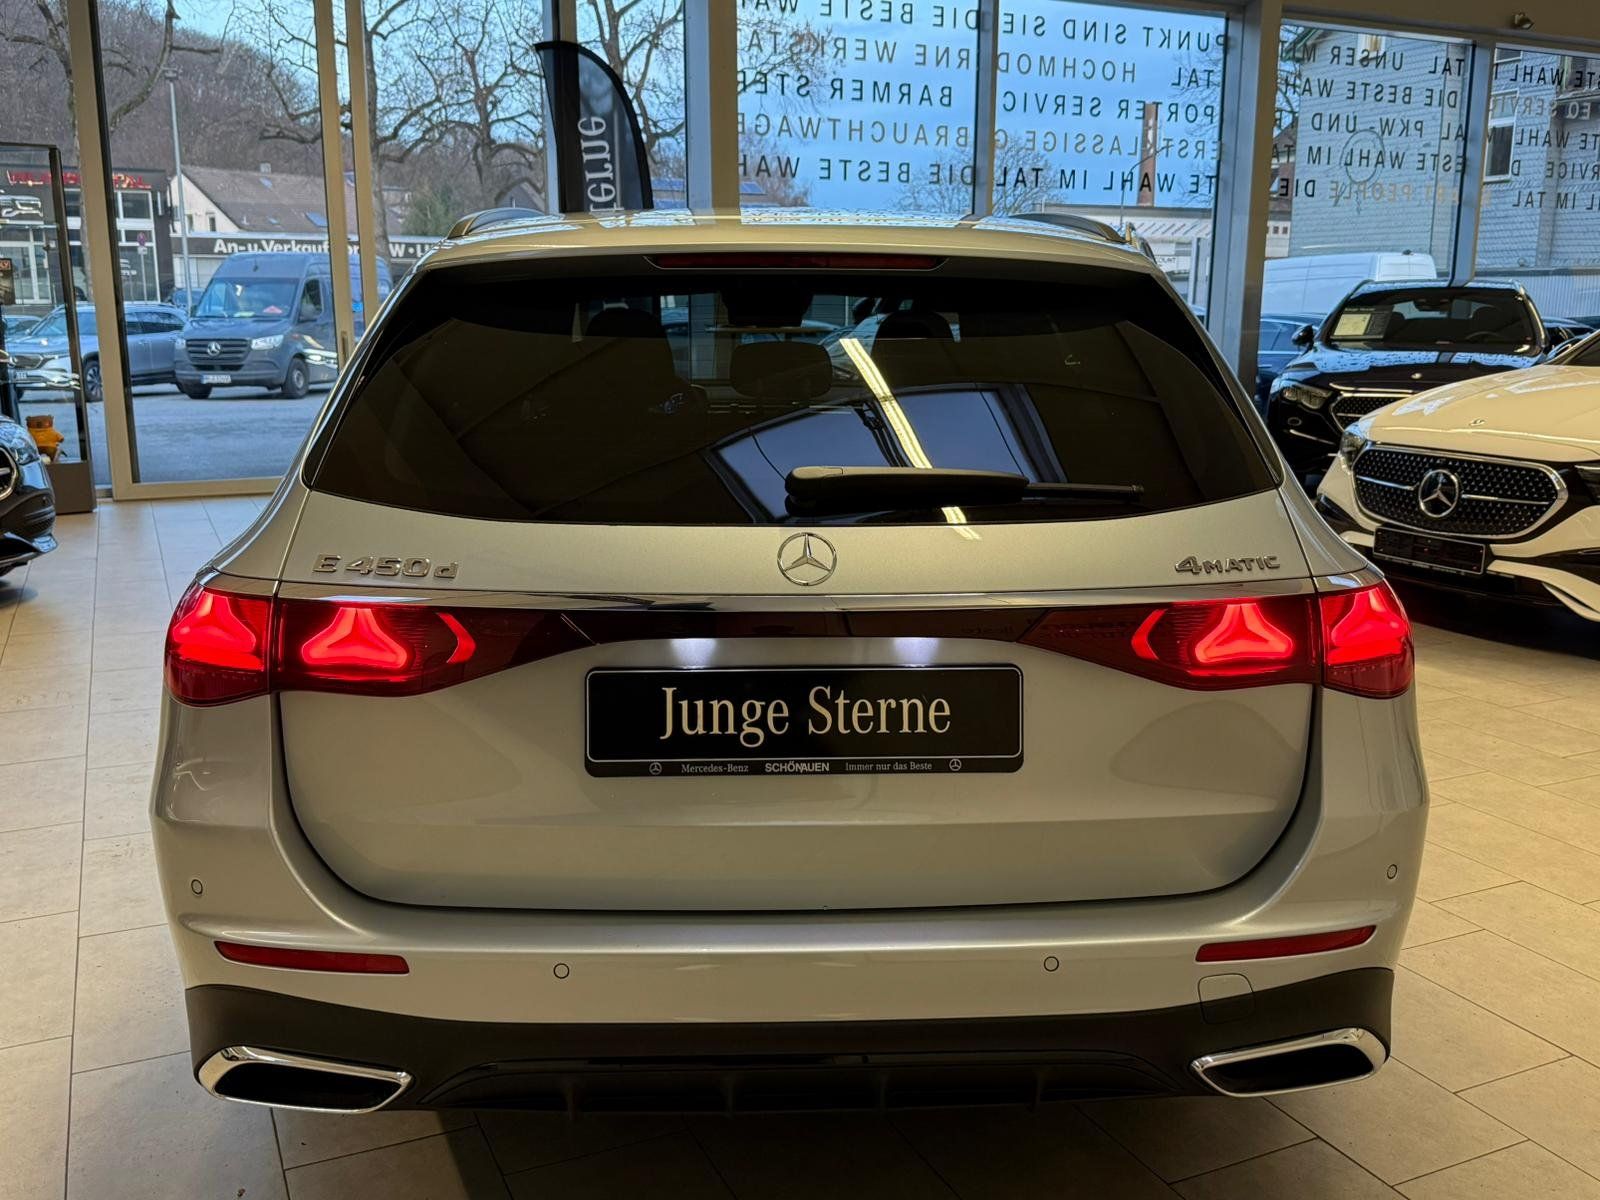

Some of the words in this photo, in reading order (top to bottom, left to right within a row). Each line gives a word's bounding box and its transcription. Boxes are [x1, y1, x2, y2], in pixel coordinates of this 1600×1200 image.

[1175, 555, 1281, 575] 4MATIC
[660, 687, 789, 748] Junge
[808, 685, 951, 735] Sterne
[681, 762, 749, 774] Mercedes-Benz
[845, 762, 873, 772] Immer
[876, 763, 890, 771] nur
[893, 761, 907, 771] das
[910, 761, 932, 771] Beste
